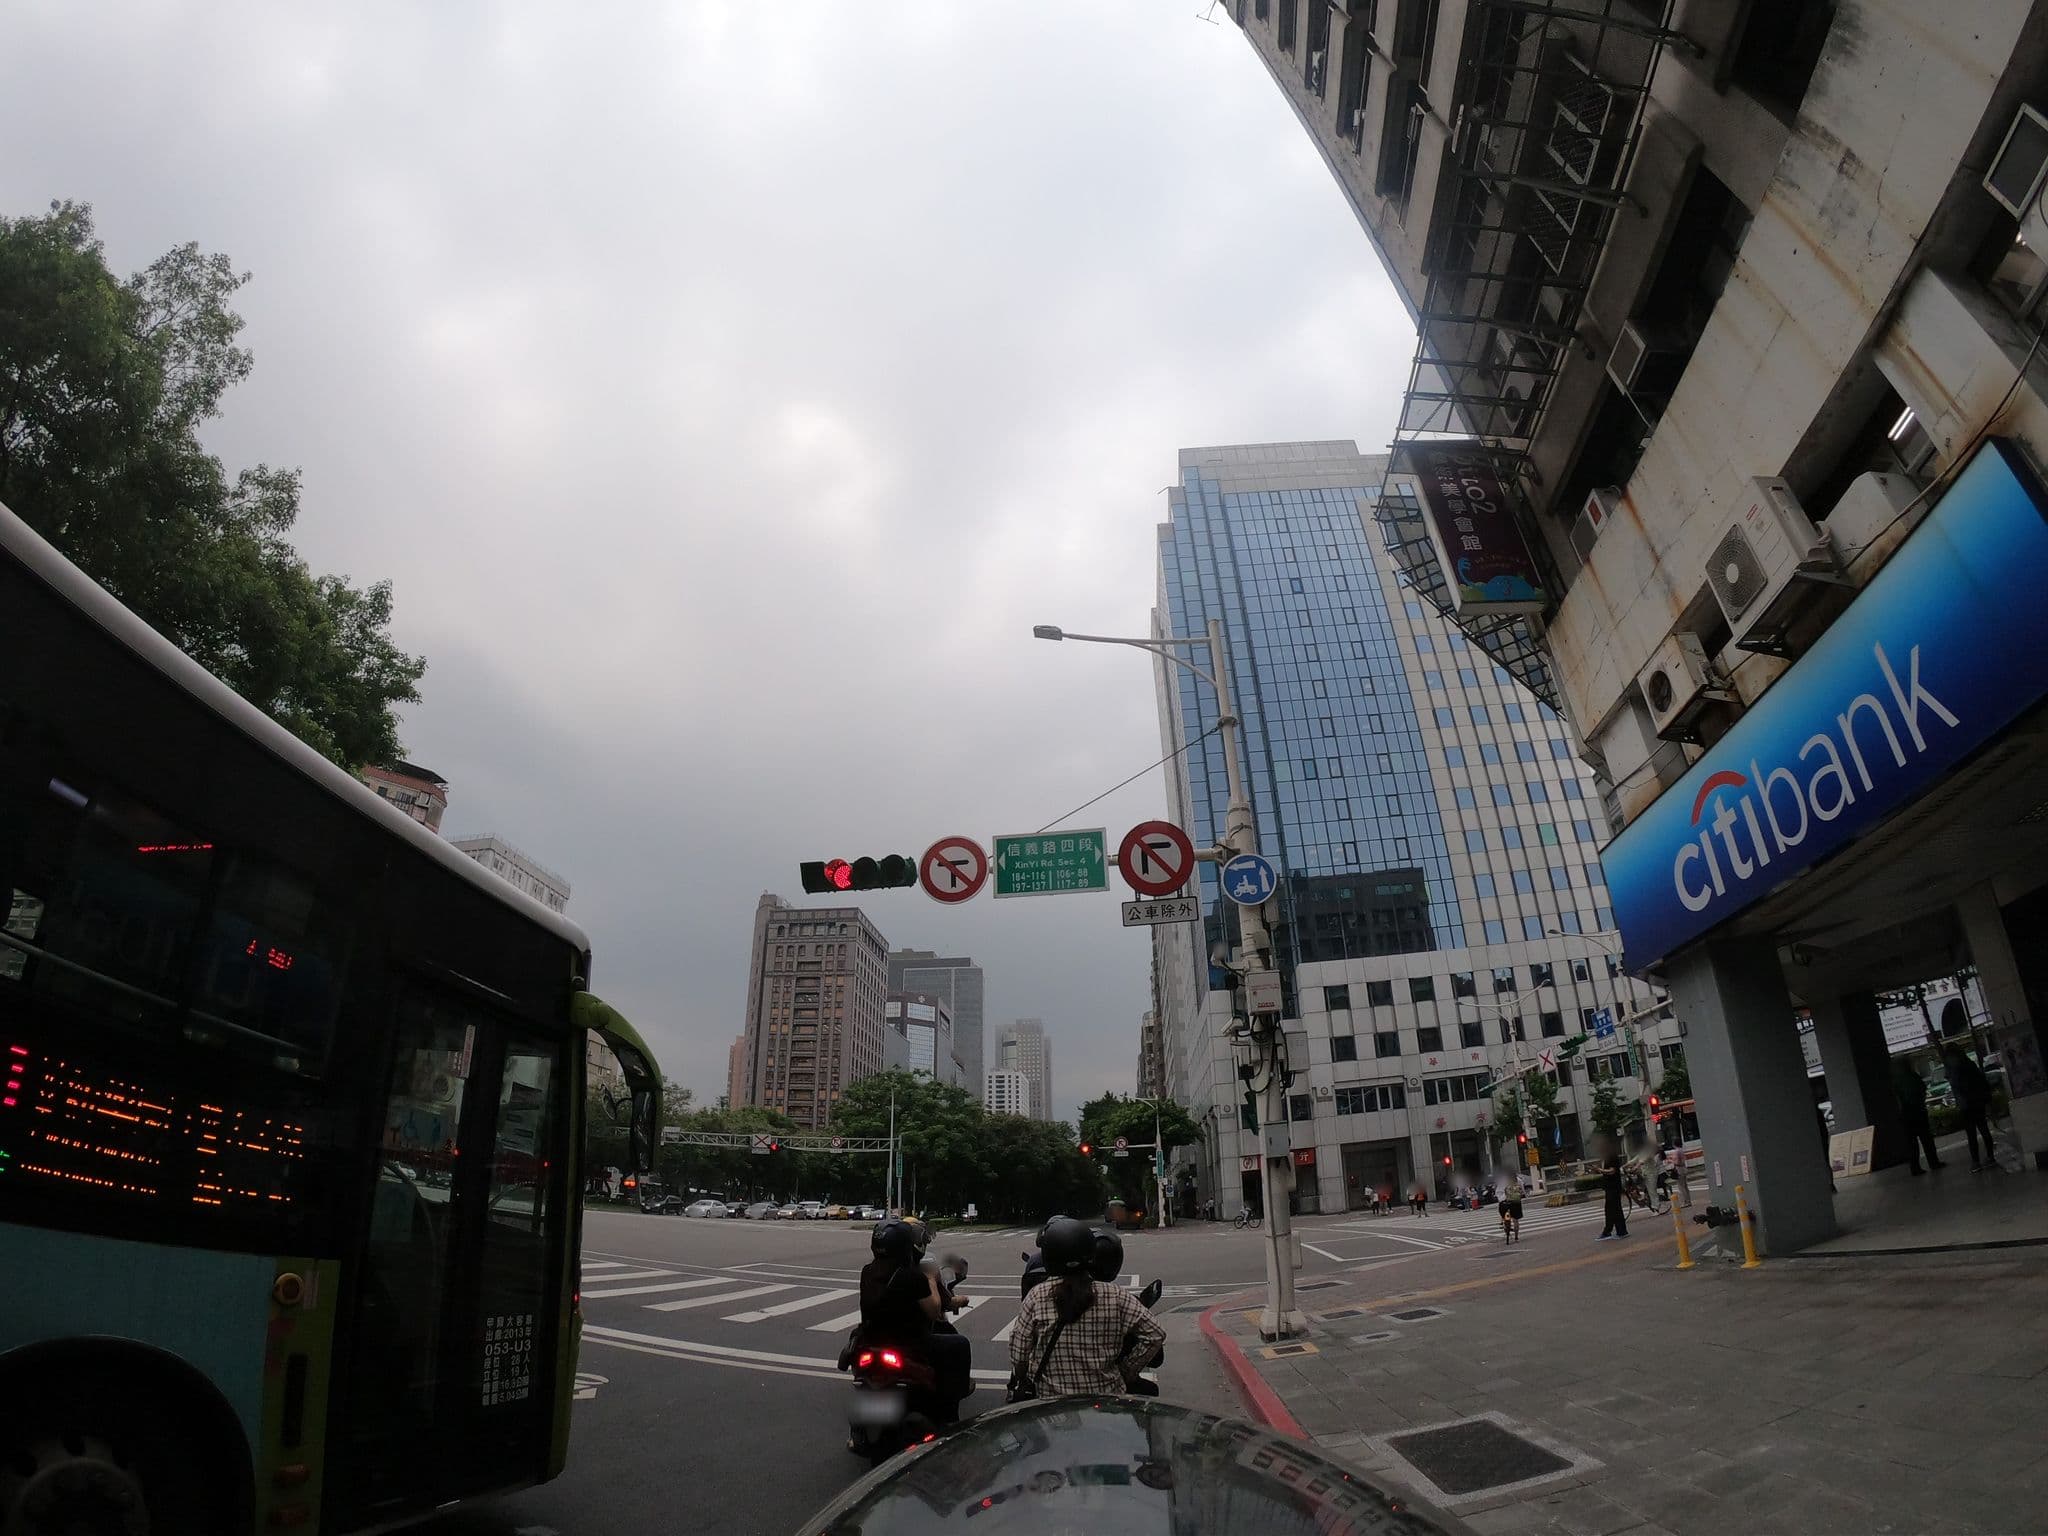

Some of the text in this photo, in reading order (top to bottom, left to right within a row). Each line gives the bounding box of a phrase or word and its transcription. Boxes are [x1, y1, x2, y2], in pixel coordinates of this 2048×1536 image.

[1674, 641, 1960, 912] citibank
[1008, 838, 1093, 857] 信義路四段
[1041, 859, 1054, 868] Rd.
[1058, 858, 1075, 867] Sec.
[1080, 857, 1086, 865] 4
[1012, 871, 1046, 882] 184-116
[1012, 881, 1046, 892] 197-137
[1128, 902, 1192, 921] 公車除外
[485, 1338, 532, 1356] 053-U3
